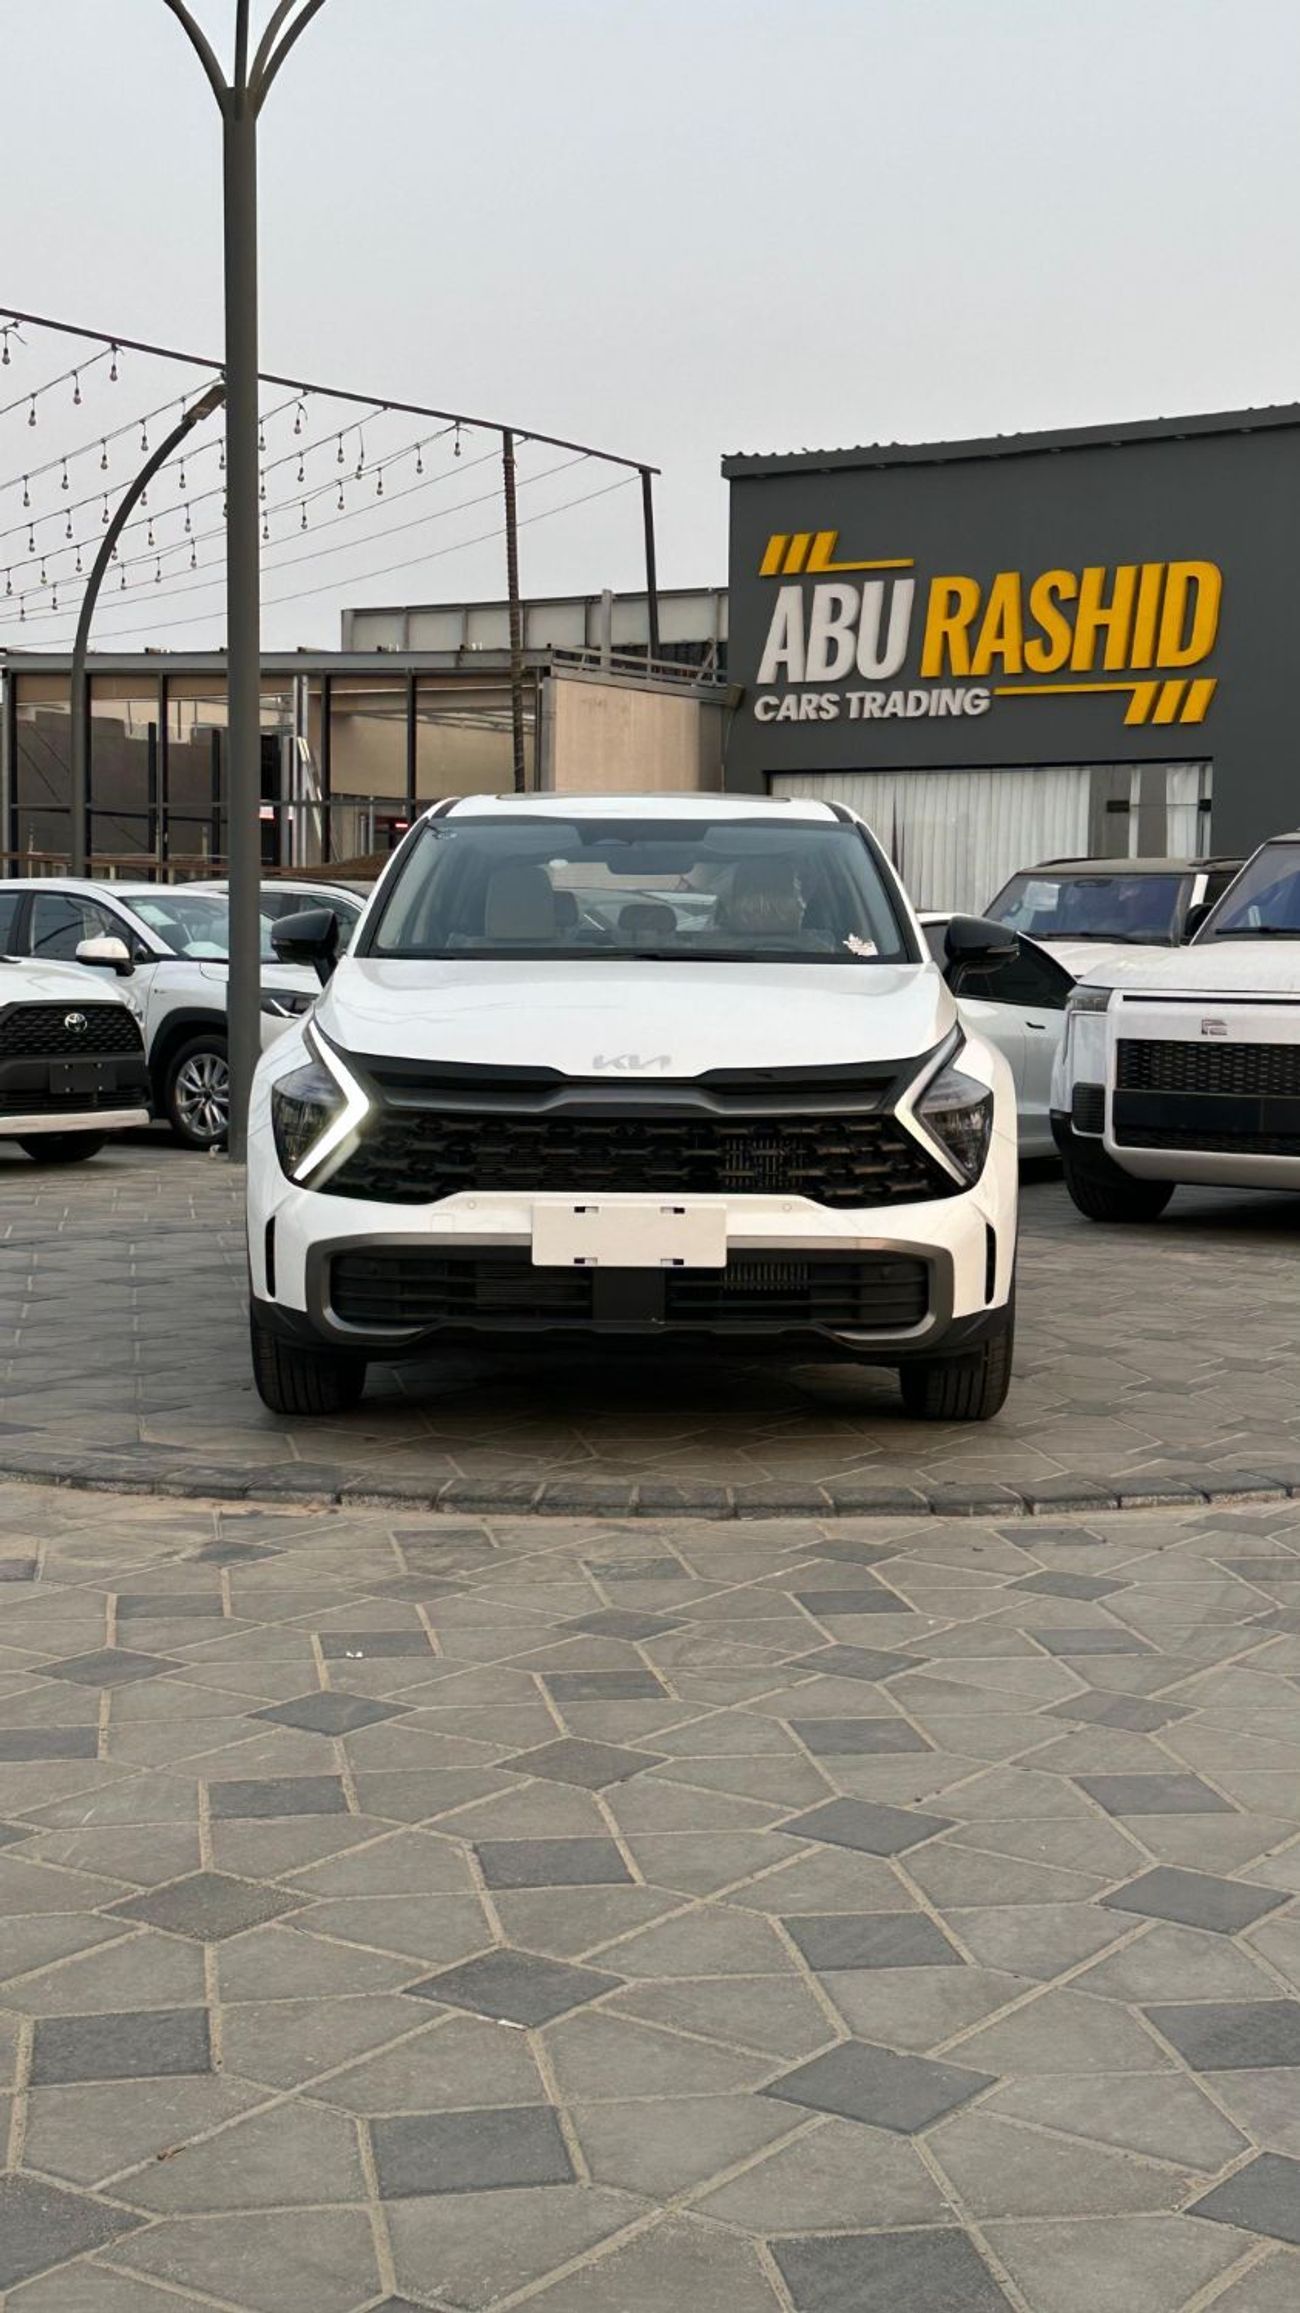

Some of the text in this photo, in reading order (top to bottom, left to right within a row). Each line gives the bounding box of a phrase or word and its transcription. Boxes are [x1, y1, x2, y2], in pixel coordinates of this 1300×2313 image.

[756, 560, 1222, 684] ABU RASHID
[754, 687, 991, 722] CARS TRADING
